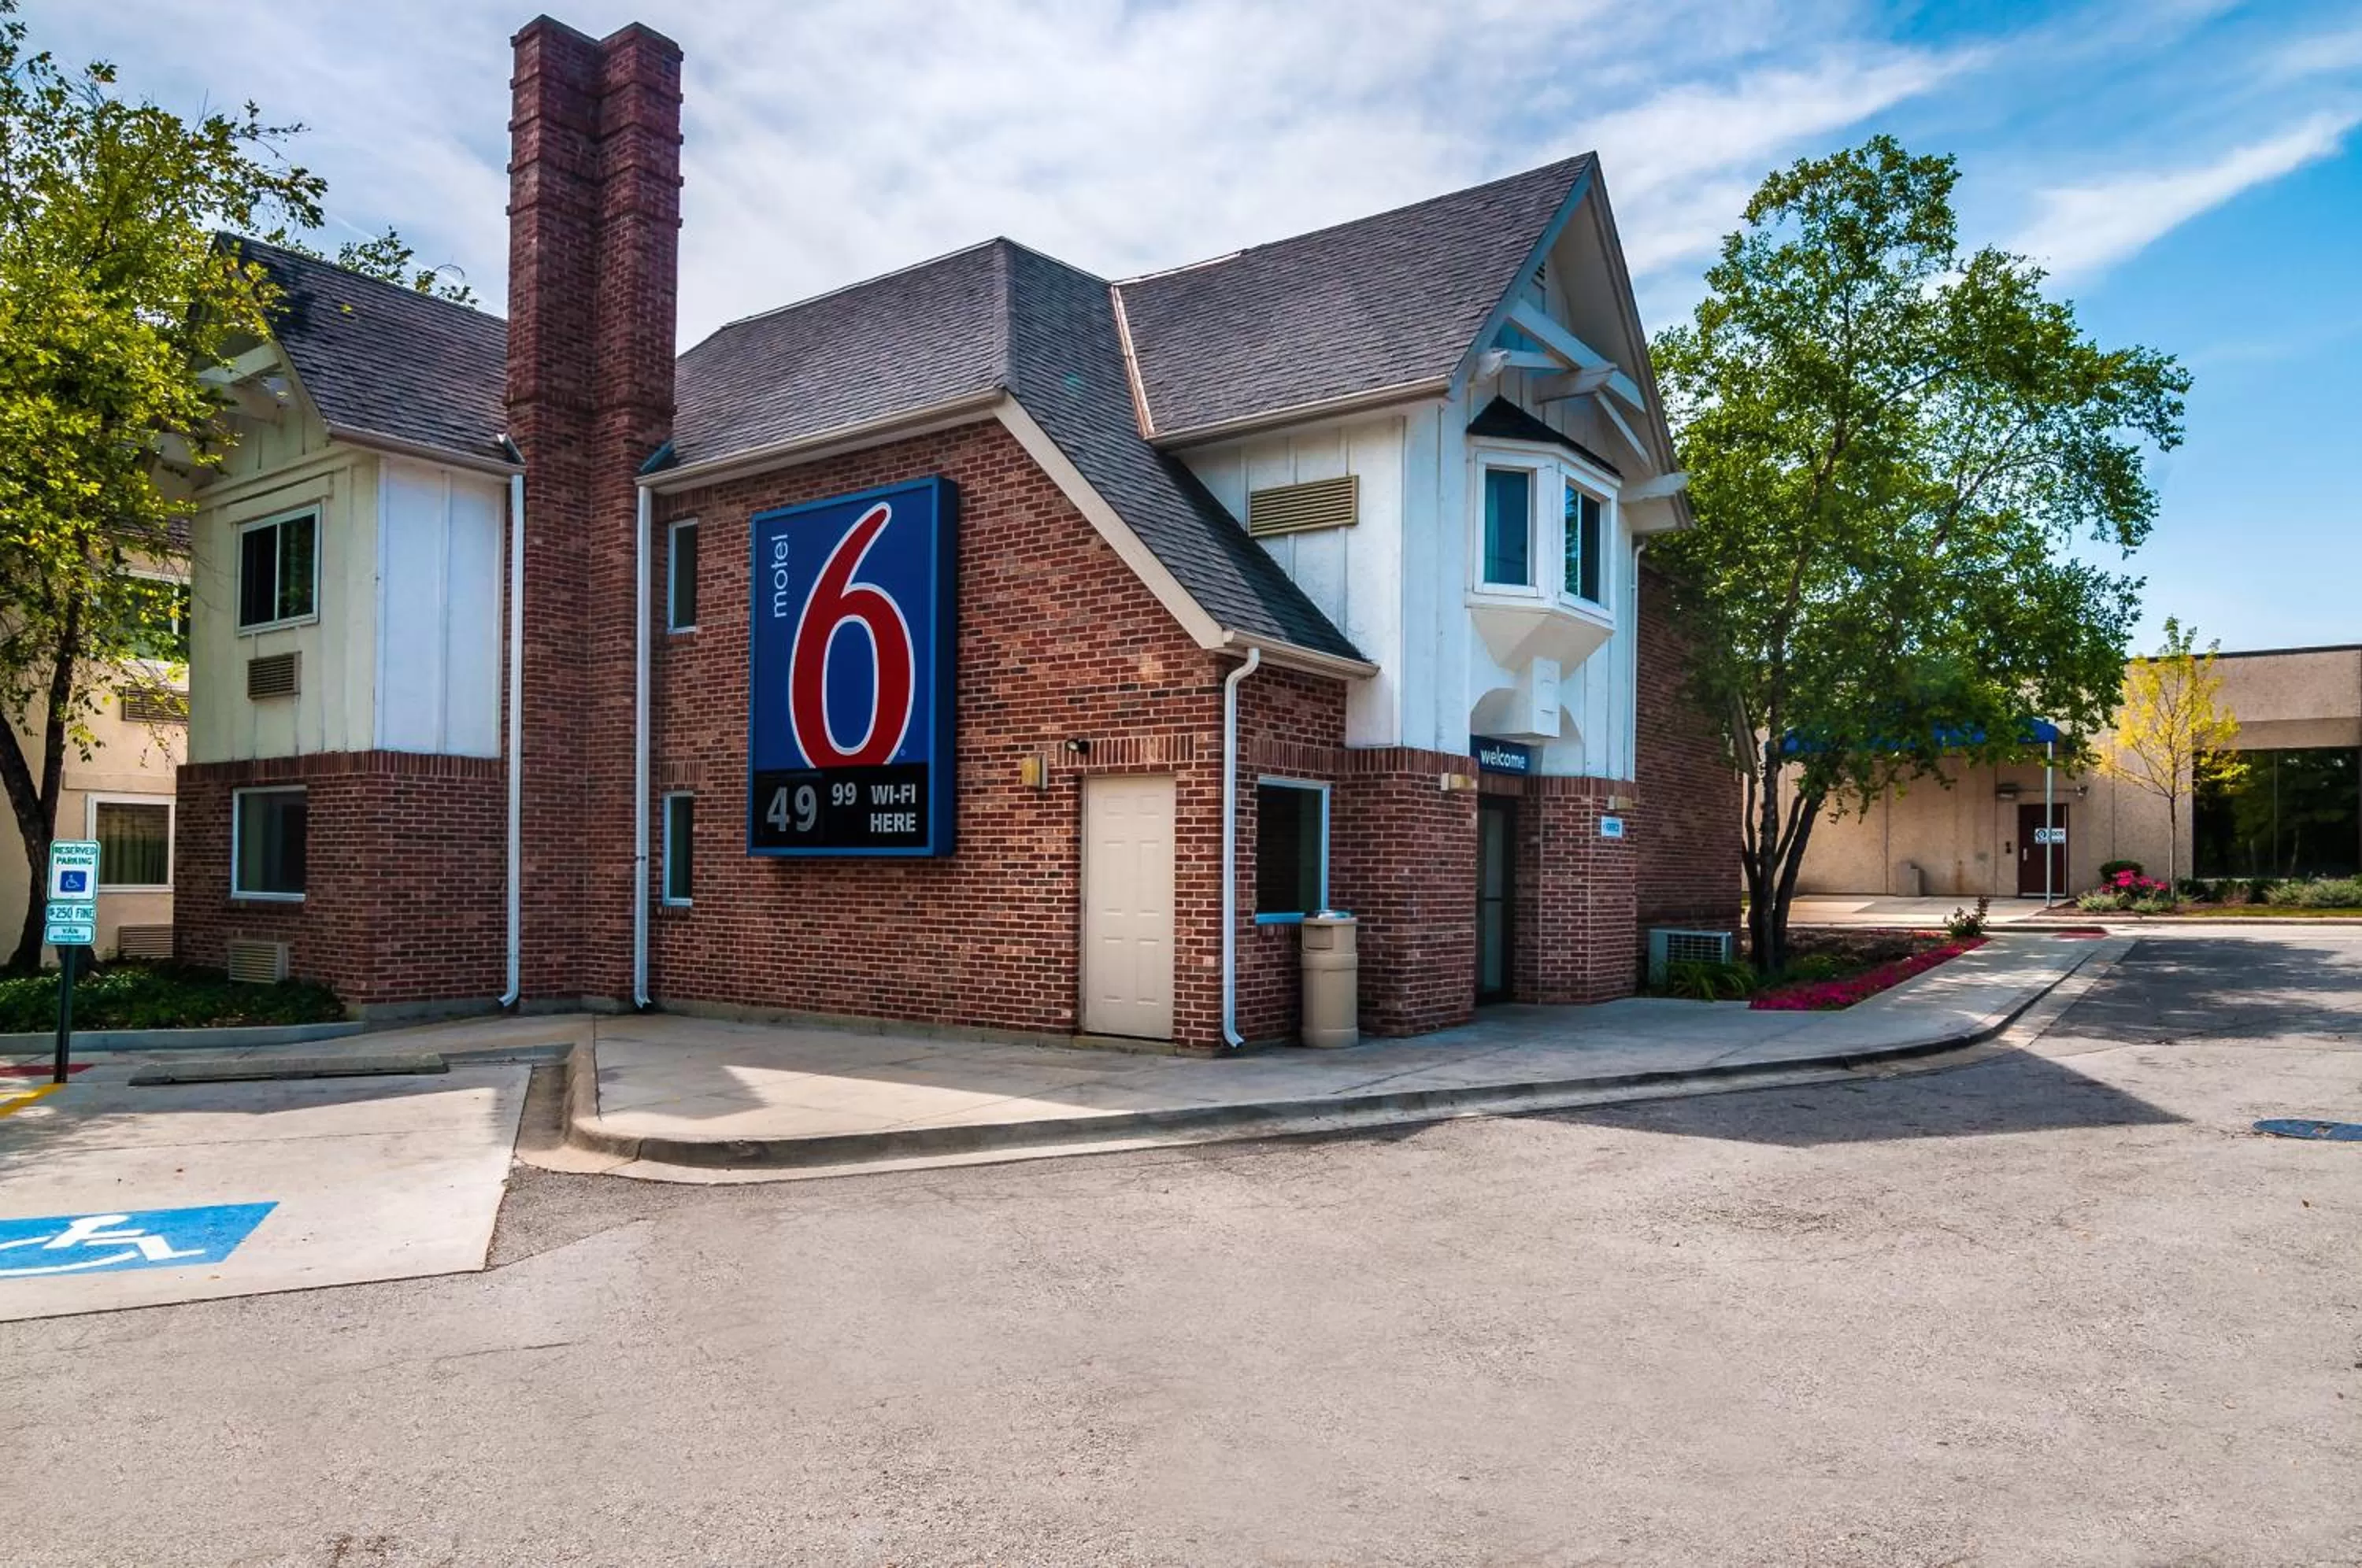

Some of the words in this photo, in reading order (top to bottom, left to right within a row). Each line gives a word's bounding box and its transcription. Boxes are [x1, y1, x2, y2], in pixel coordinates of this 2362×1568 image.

[772, 534, 789, 619] motel
[788, 501, 916, 769] 6
[1479, 746, 1526, 769] welcome
[870, 782, 916, 805] WI-FI
[766, 784, 818, 833] 49
[831, 782, 857, 806] 99
[870, 812, 916, 833] HERE
[54, 846, 96, 856] RESERVED
[56, 856, 93, 865] PARKING
[49, 907, 73, 919] $250
[76, 908, 94, 919] FINE
